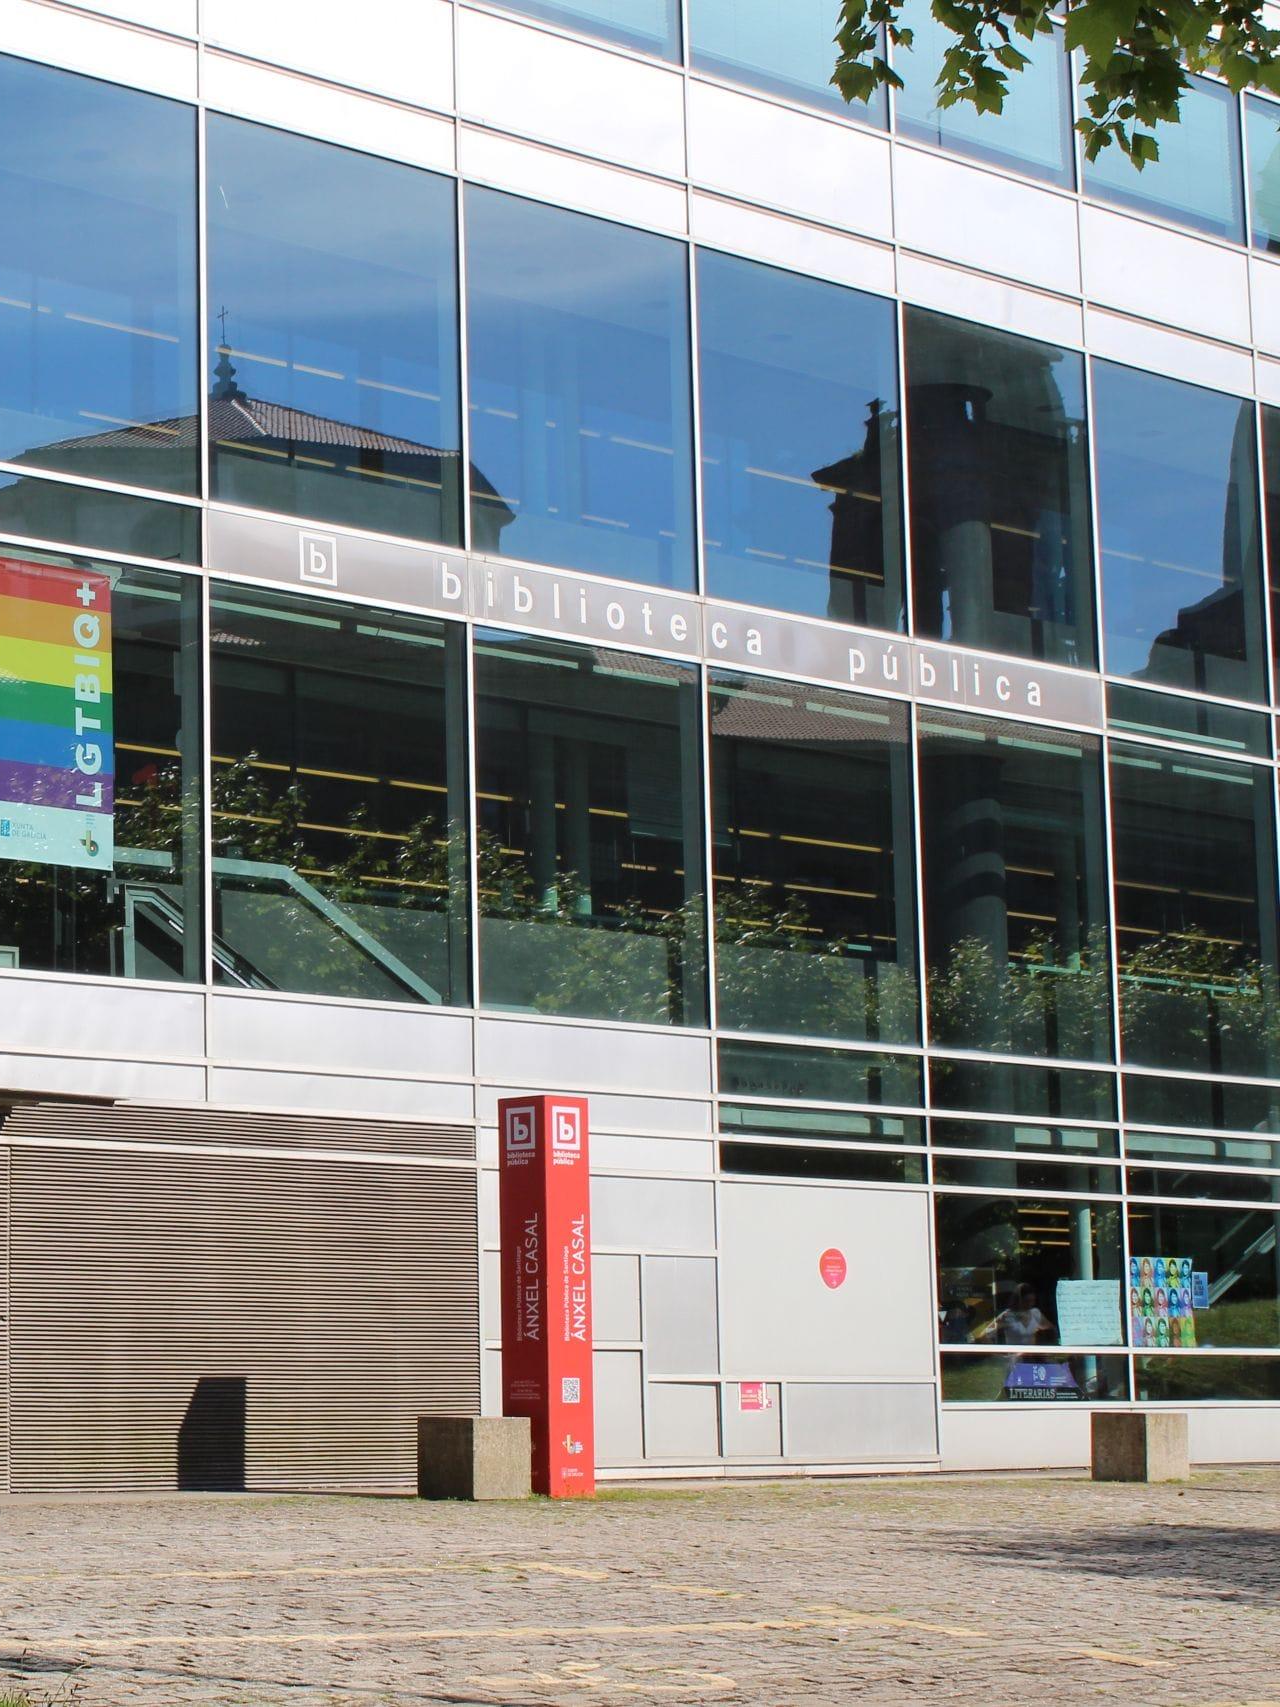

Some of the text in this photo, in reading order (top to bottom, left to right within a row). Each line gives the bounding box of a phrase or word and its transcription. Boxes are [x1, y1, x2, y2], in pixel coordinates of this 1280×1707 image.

[73, 580, 102, 808] LGTBIQ+
[441, 562, 762, 656] biblioteca
[848, 645, 1041, 706] pública
[523, 1212, 539, 1340] ÁNXEL CASAL
[571, 1214, 586, 1341] ÁNXEL CASAL
[1009, 1388, 1056, 1399] LITERARIAS
